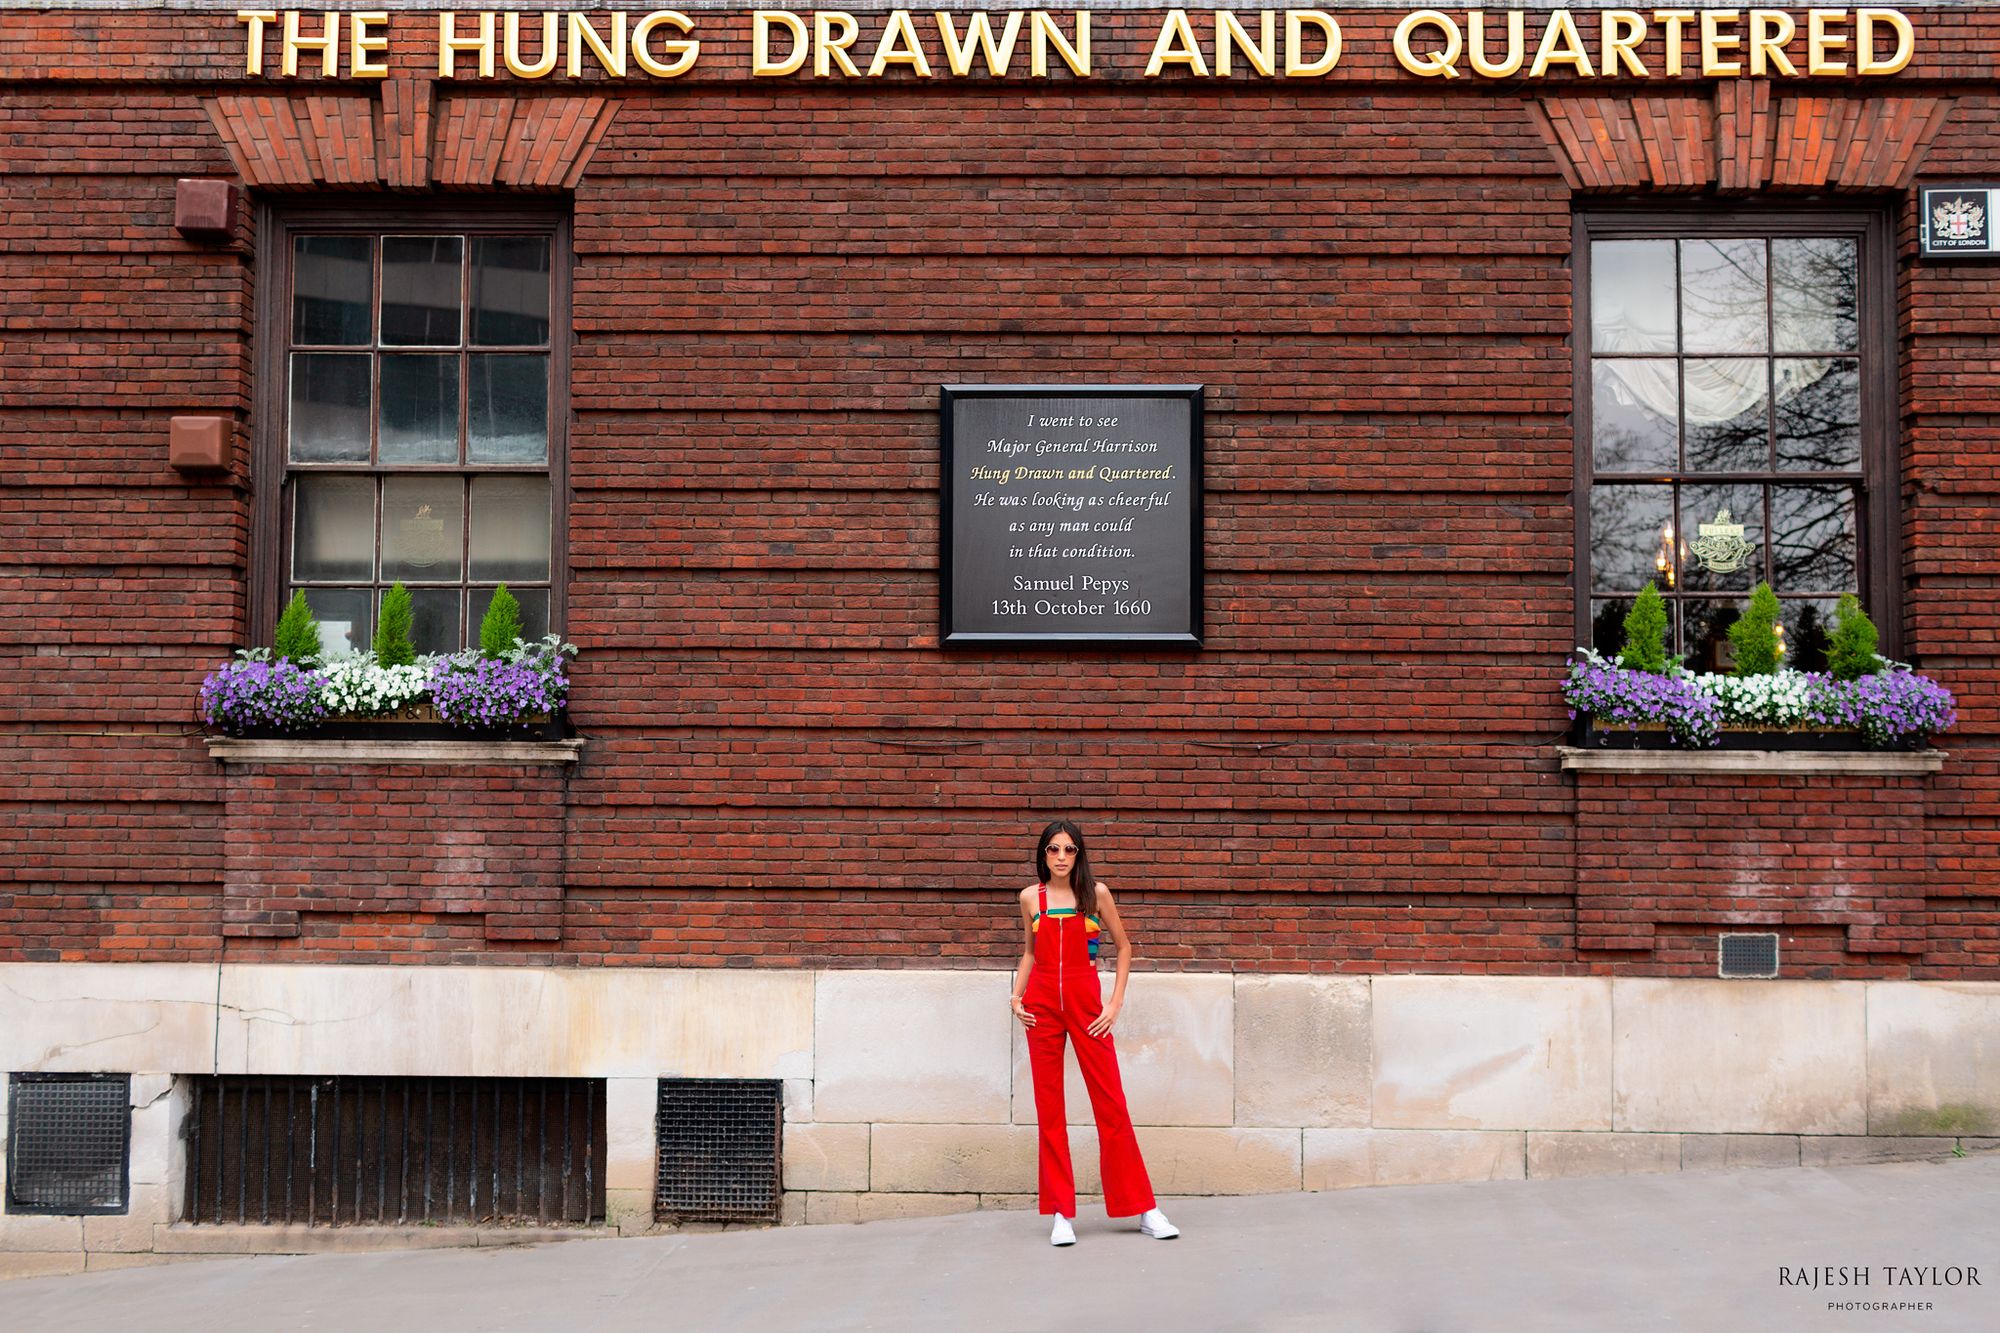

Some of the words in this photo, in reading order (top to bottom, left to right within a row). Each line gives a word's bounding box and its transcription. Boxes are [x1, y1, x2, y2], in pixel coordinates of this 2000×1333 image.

[237, 10, 389, 79] THE
[438, 10, 700, 79] HUNG
[752, 10, 1092, 78] DRAWN
[1144, 10, 1343, 78] AND
[1393, 9, 1915, 79] QUARTERED
[1028, 415, 1034, 426] I
[1040, 416, 1074, 426] went
[1080, 416, 1092, 426] to
[1097, 418, 1118, 426] see
[987, 439, 1031, 457] Major
[1036, 439, 1090, 456] General
[1092, 439, 1157, 452] Harrison
[970, 465, 1010, 484] Hung
[1015, 467, 1064, 479] Drawn
[1068, 465, 1096, 479] and
[1100, 465, 1175, 482] Quartered.
[974, 492, 994, 505] He
[999, 496, 1027, 505] was
[1032, 492, 1084, 511] looking
[1089, 497, 1104, 505] as
[1109, 492, 1171, 511] cheerful
[1010, 523, 1025, 531] as
[1030, 523, 1054, 537] any
[1060, 523, 1089, 531] man
[1094, 518, 1134, 531] could
[1010, 545, 1022, 557] in
[1029, 544, 1058, 557] that
[1063, 544, 1134, 557] condition.
[1014, 575, 1073, 590] Samuel
[1082, 576, 1128, 594] Pepys
[993, 600, 1026, 614] 13th
[1035, 600, 1105, 614] October
[1114, 600, 1150, 614] 1660
